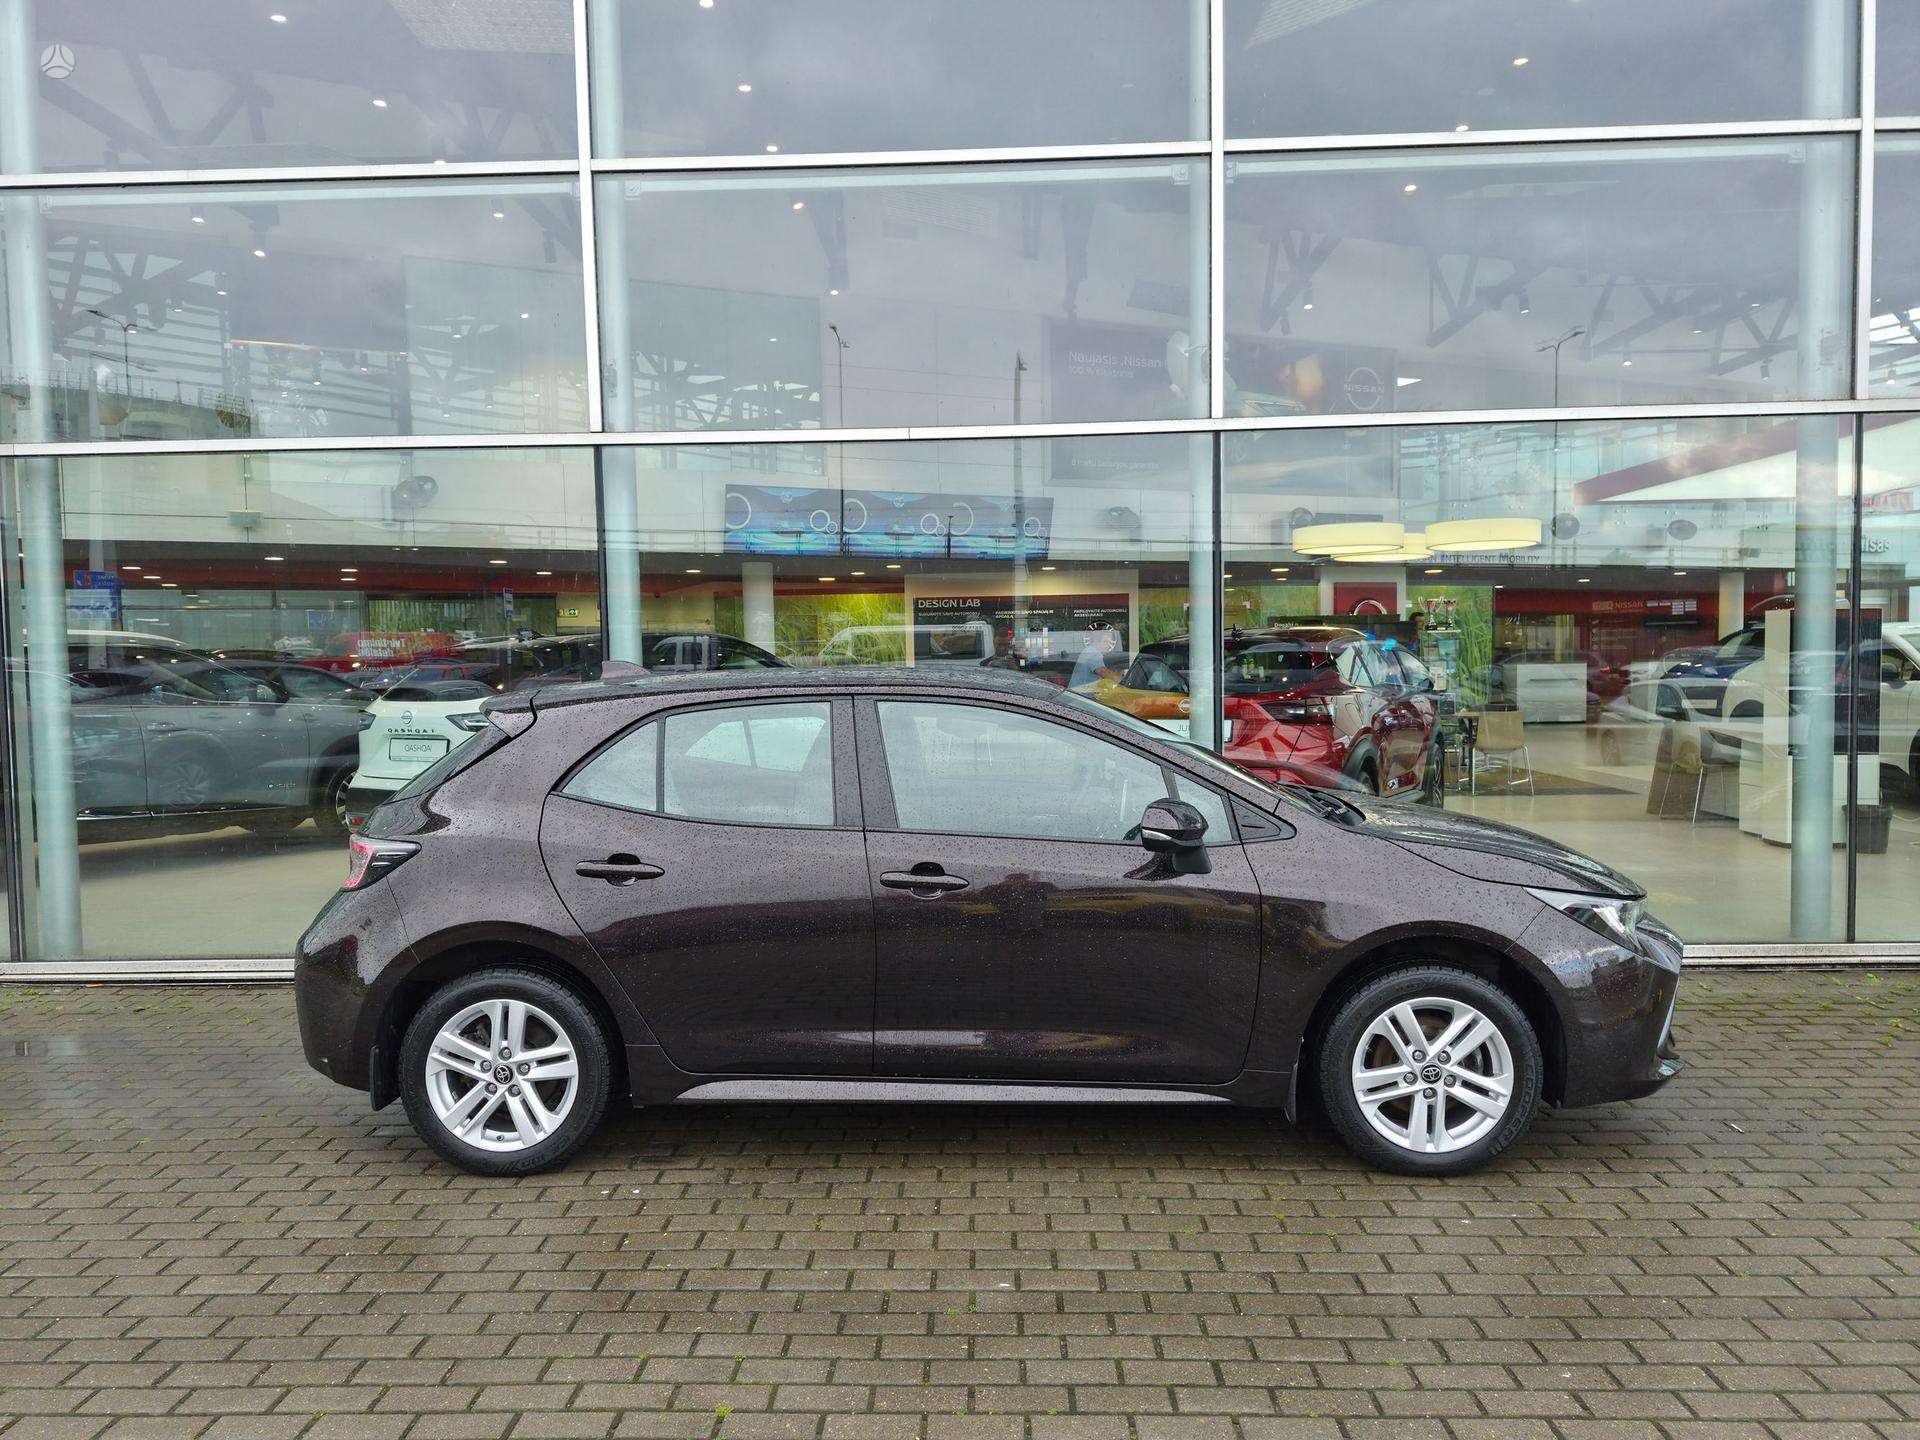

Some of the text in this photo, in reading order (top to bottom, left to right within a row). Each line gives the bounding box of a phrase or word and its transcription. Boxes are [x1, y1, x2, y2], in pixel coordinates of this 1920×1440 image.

[1343, 383, 1385, 394] NISSAN
[1440, 551, 1496, 563] INTELLIGENT
[918, 598, 981, 608] DESIGN LAB
